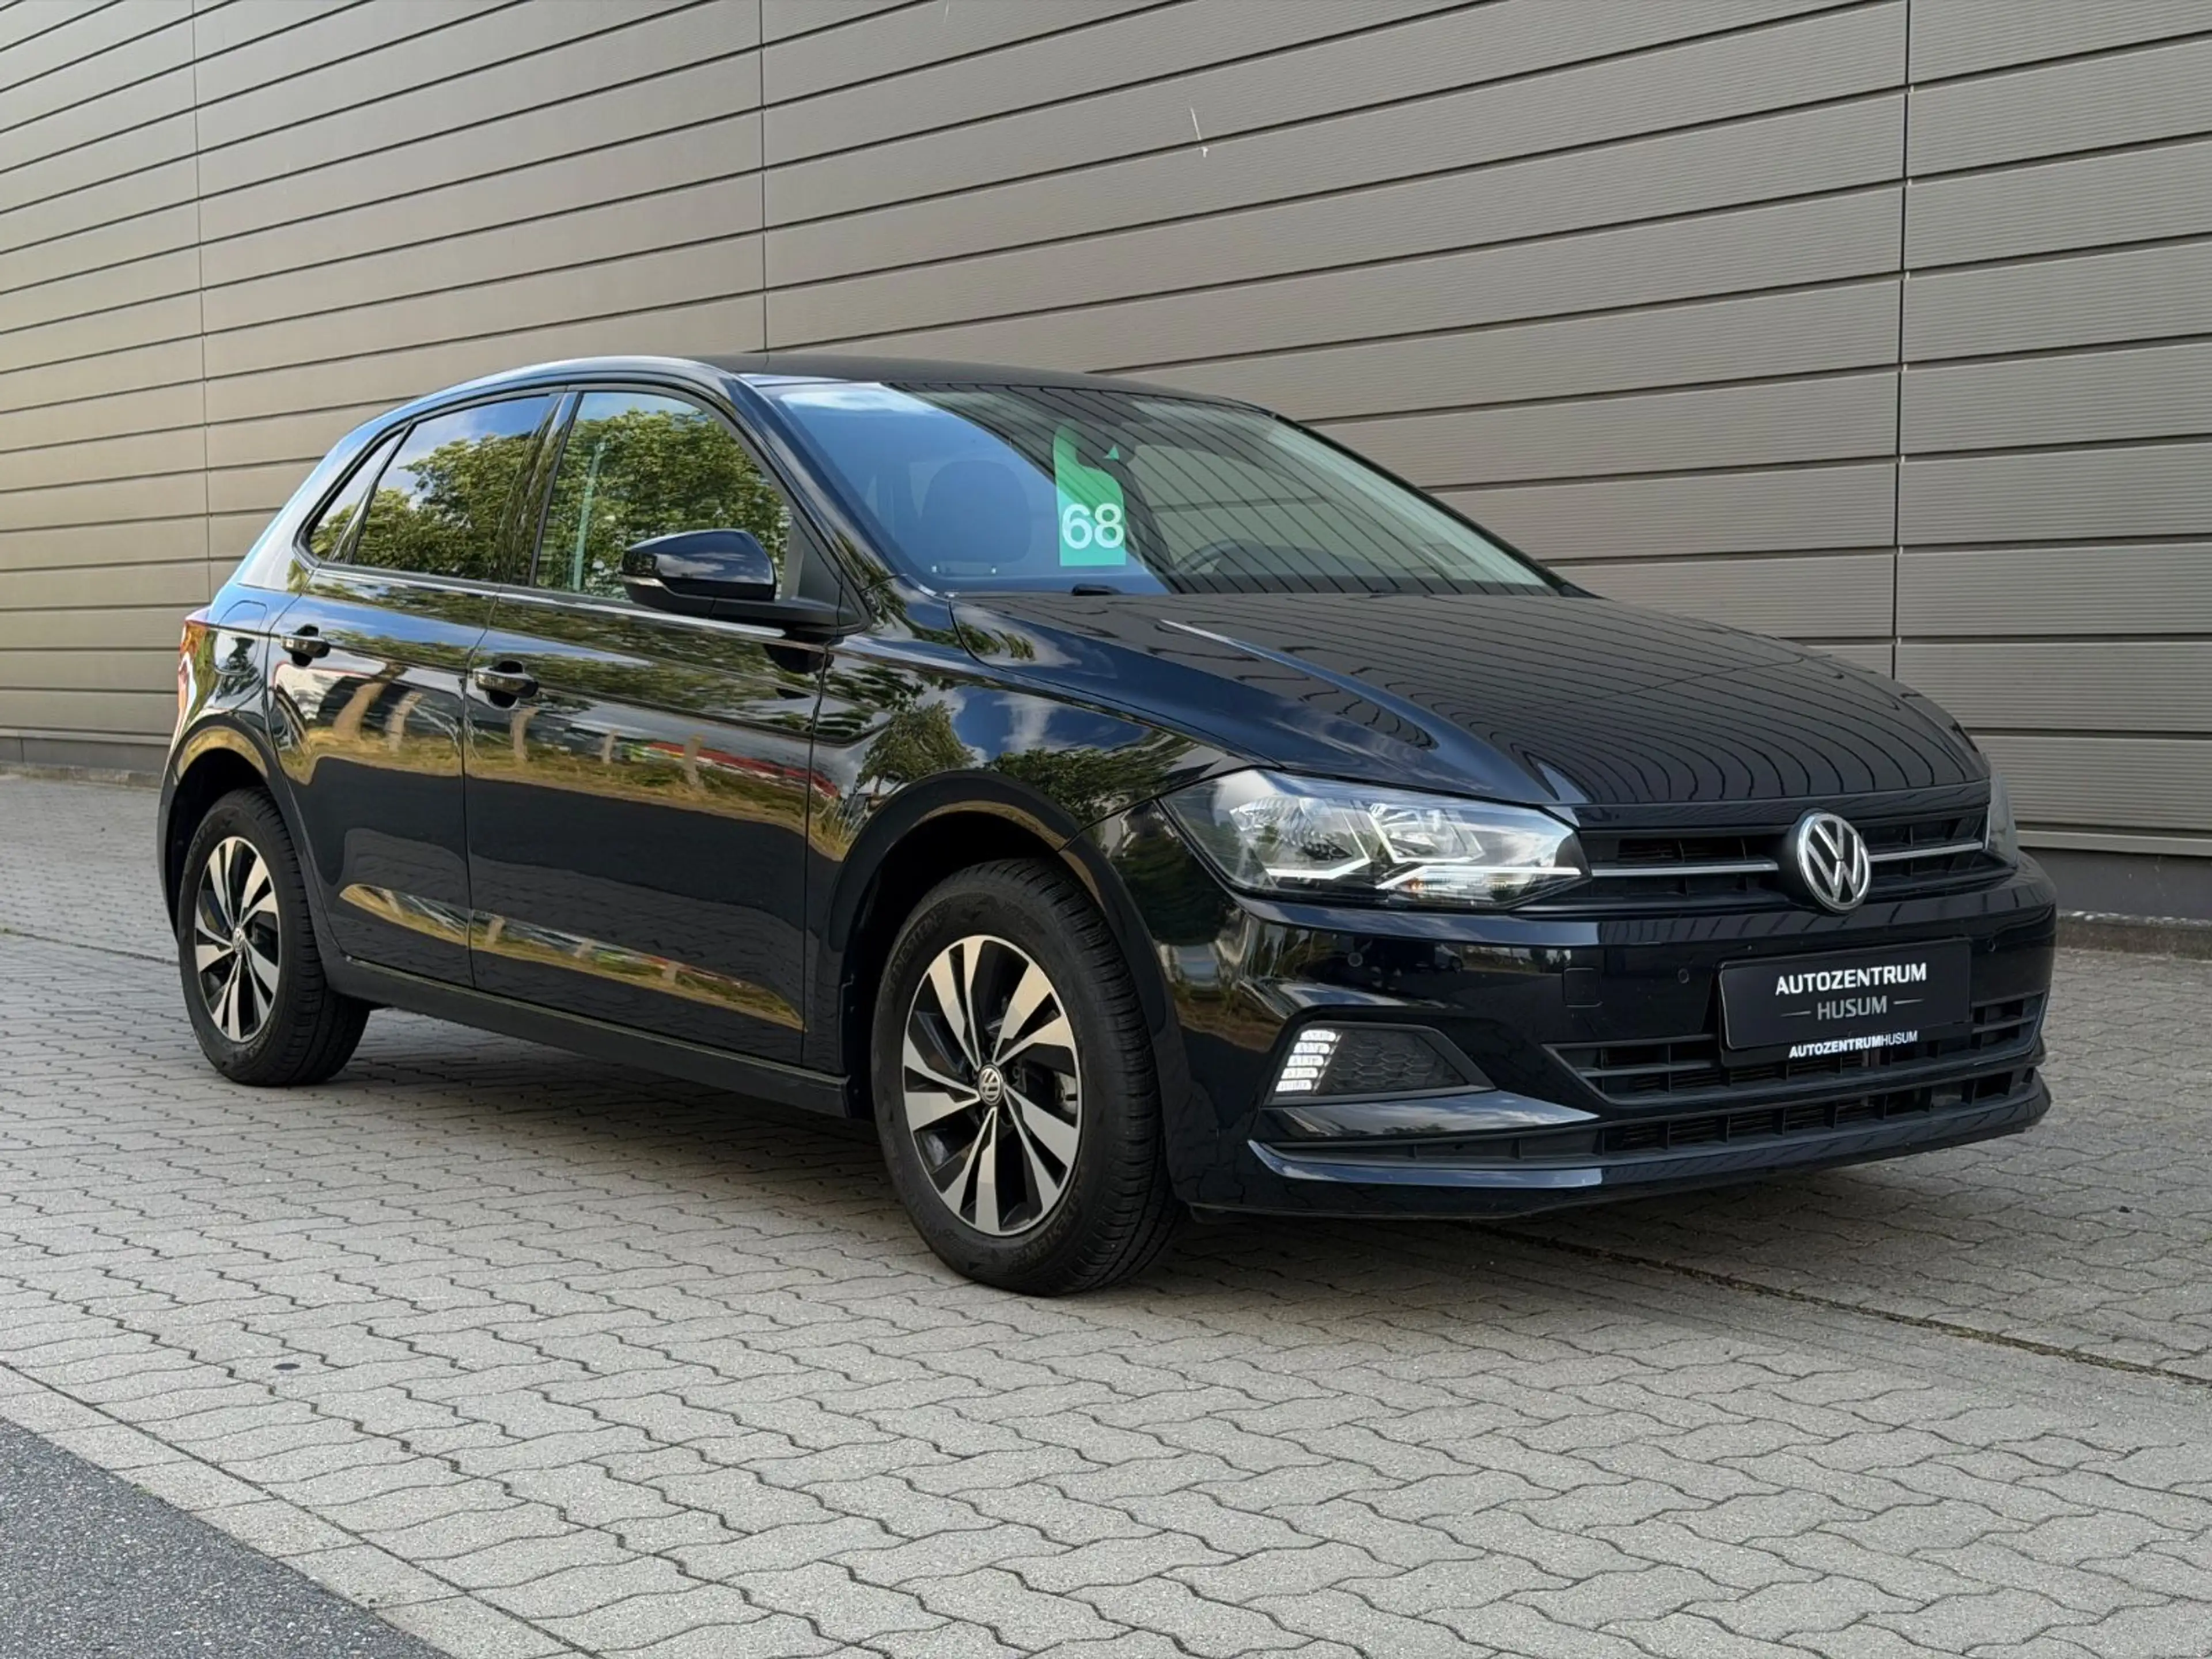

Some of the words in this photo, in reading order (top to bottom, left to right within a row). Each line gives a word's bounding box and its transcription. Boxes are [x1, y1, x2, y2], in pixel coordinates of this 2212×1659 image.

[1062, 502, 1124, 550] 68
[1775, 962, 1927, 997] AUTOZENTRUM
[1817, 995, 1888, 1021] HUSUM
[1788, 1030, 1918, 1059] AUTOZENTRUMHUSUM
